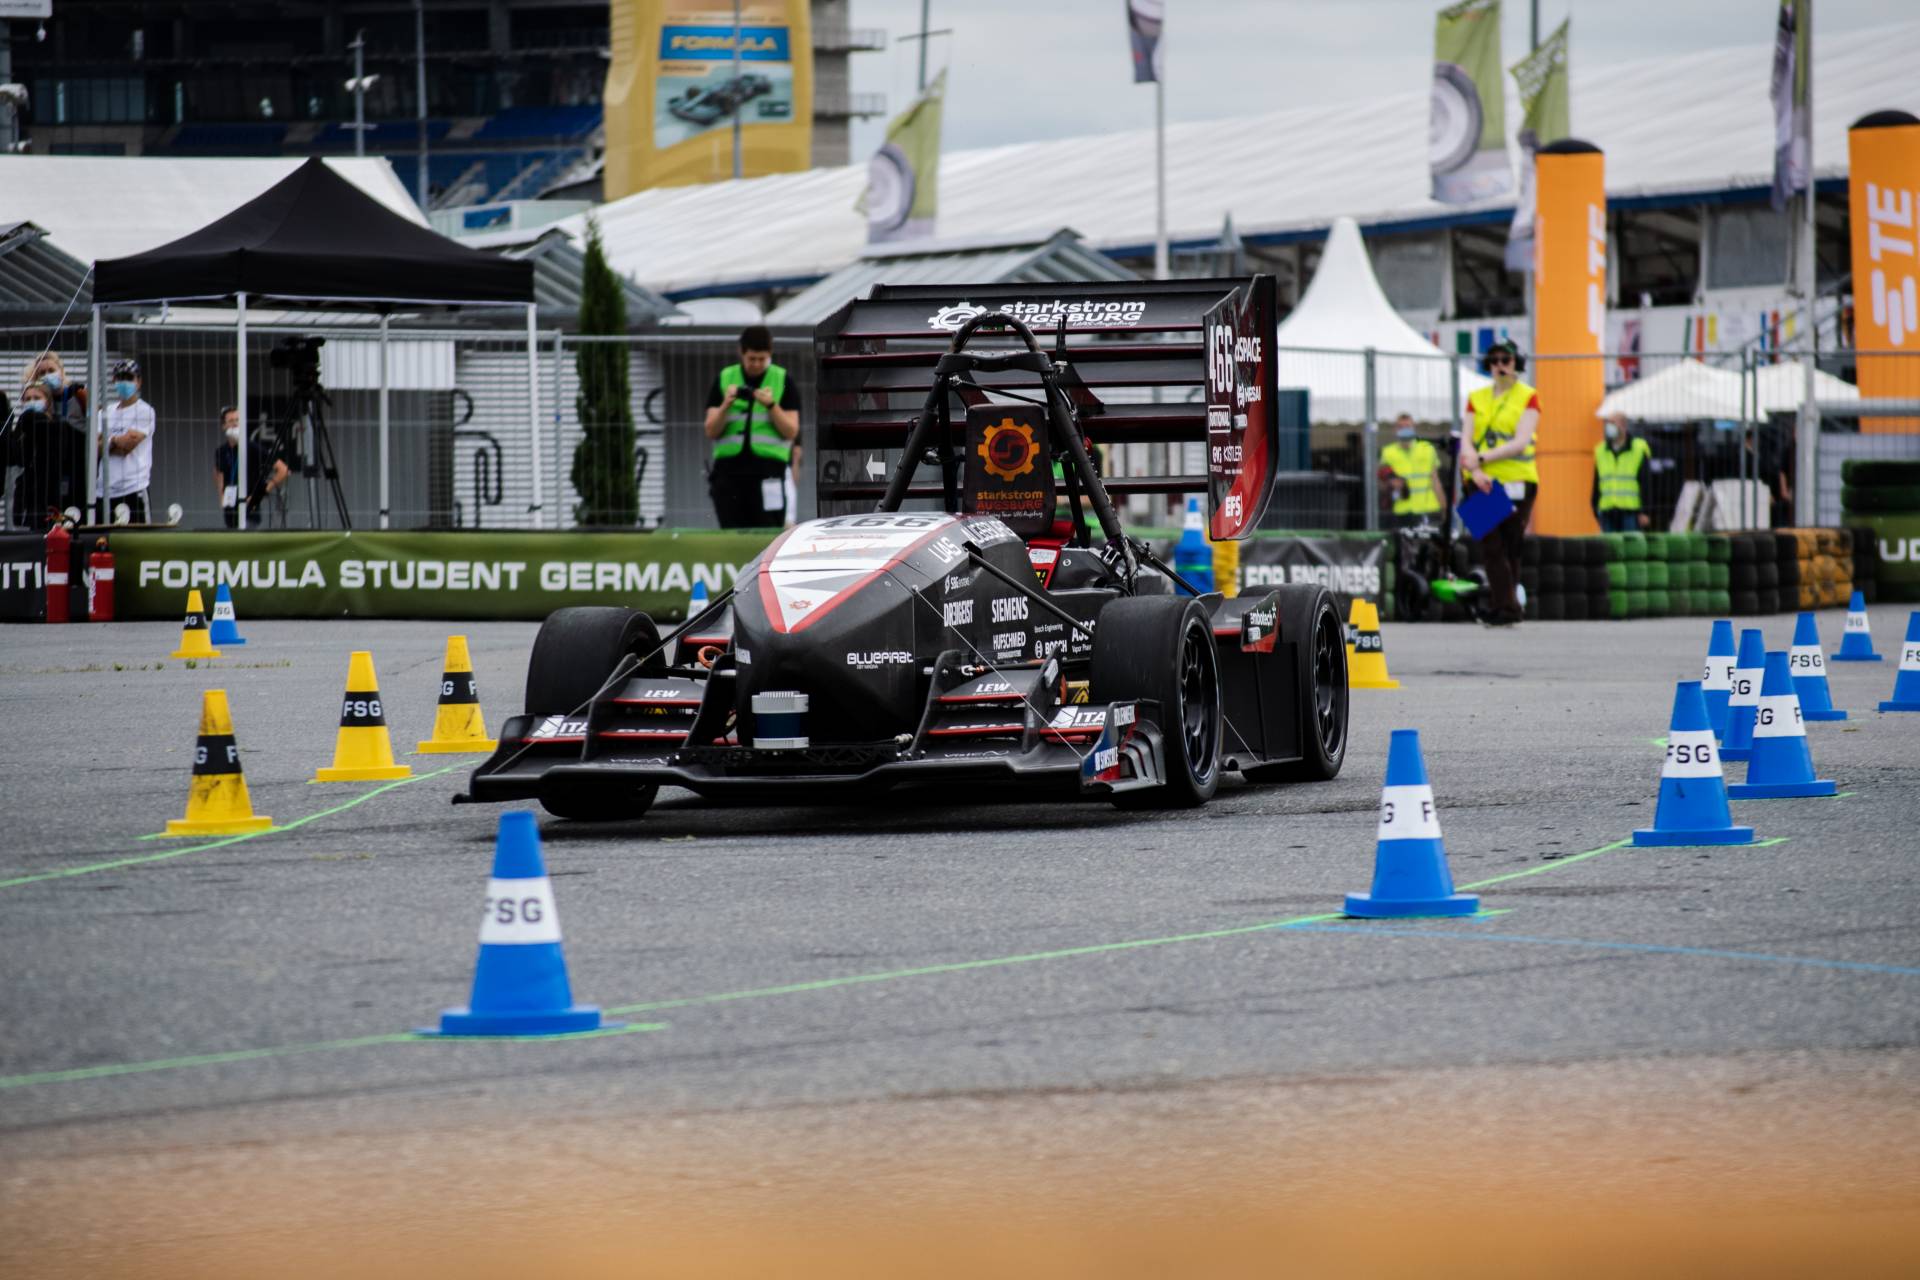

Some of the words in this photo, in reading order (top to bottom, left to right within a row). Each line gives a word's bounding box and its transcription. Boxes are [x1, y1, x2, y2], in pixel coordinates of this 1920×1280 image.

[1000, 300, 1146, 314] starkstrom
[1014, 312, 1143, 323] UGSBURG
[1235, 337, 1262, 362] dSPACE
[1209, 325, 1233, 393] 466
[976, 490, 1043, 500] starkstrom
[976, 500, 1043, 510] AUGSBURG
[815, 516, 938, 528] 466
[928, 537, 962, 563] UAS
[139, 560, 326, 588] FORMULA
[339, 561, 526, 590] STUDENT
[1290, 563, 1380, 594] ENGINEERS
[991, 595, 1029, 623] SIEMENS
[992, 631, 1027, 651] HUFSCHMIED
[1791, 655, 1822, 668] FSG
[645, 690, 681, 698] LEW
[975, 683, 1011, 693] LEW
[343, 700, 381, 717] FSG
